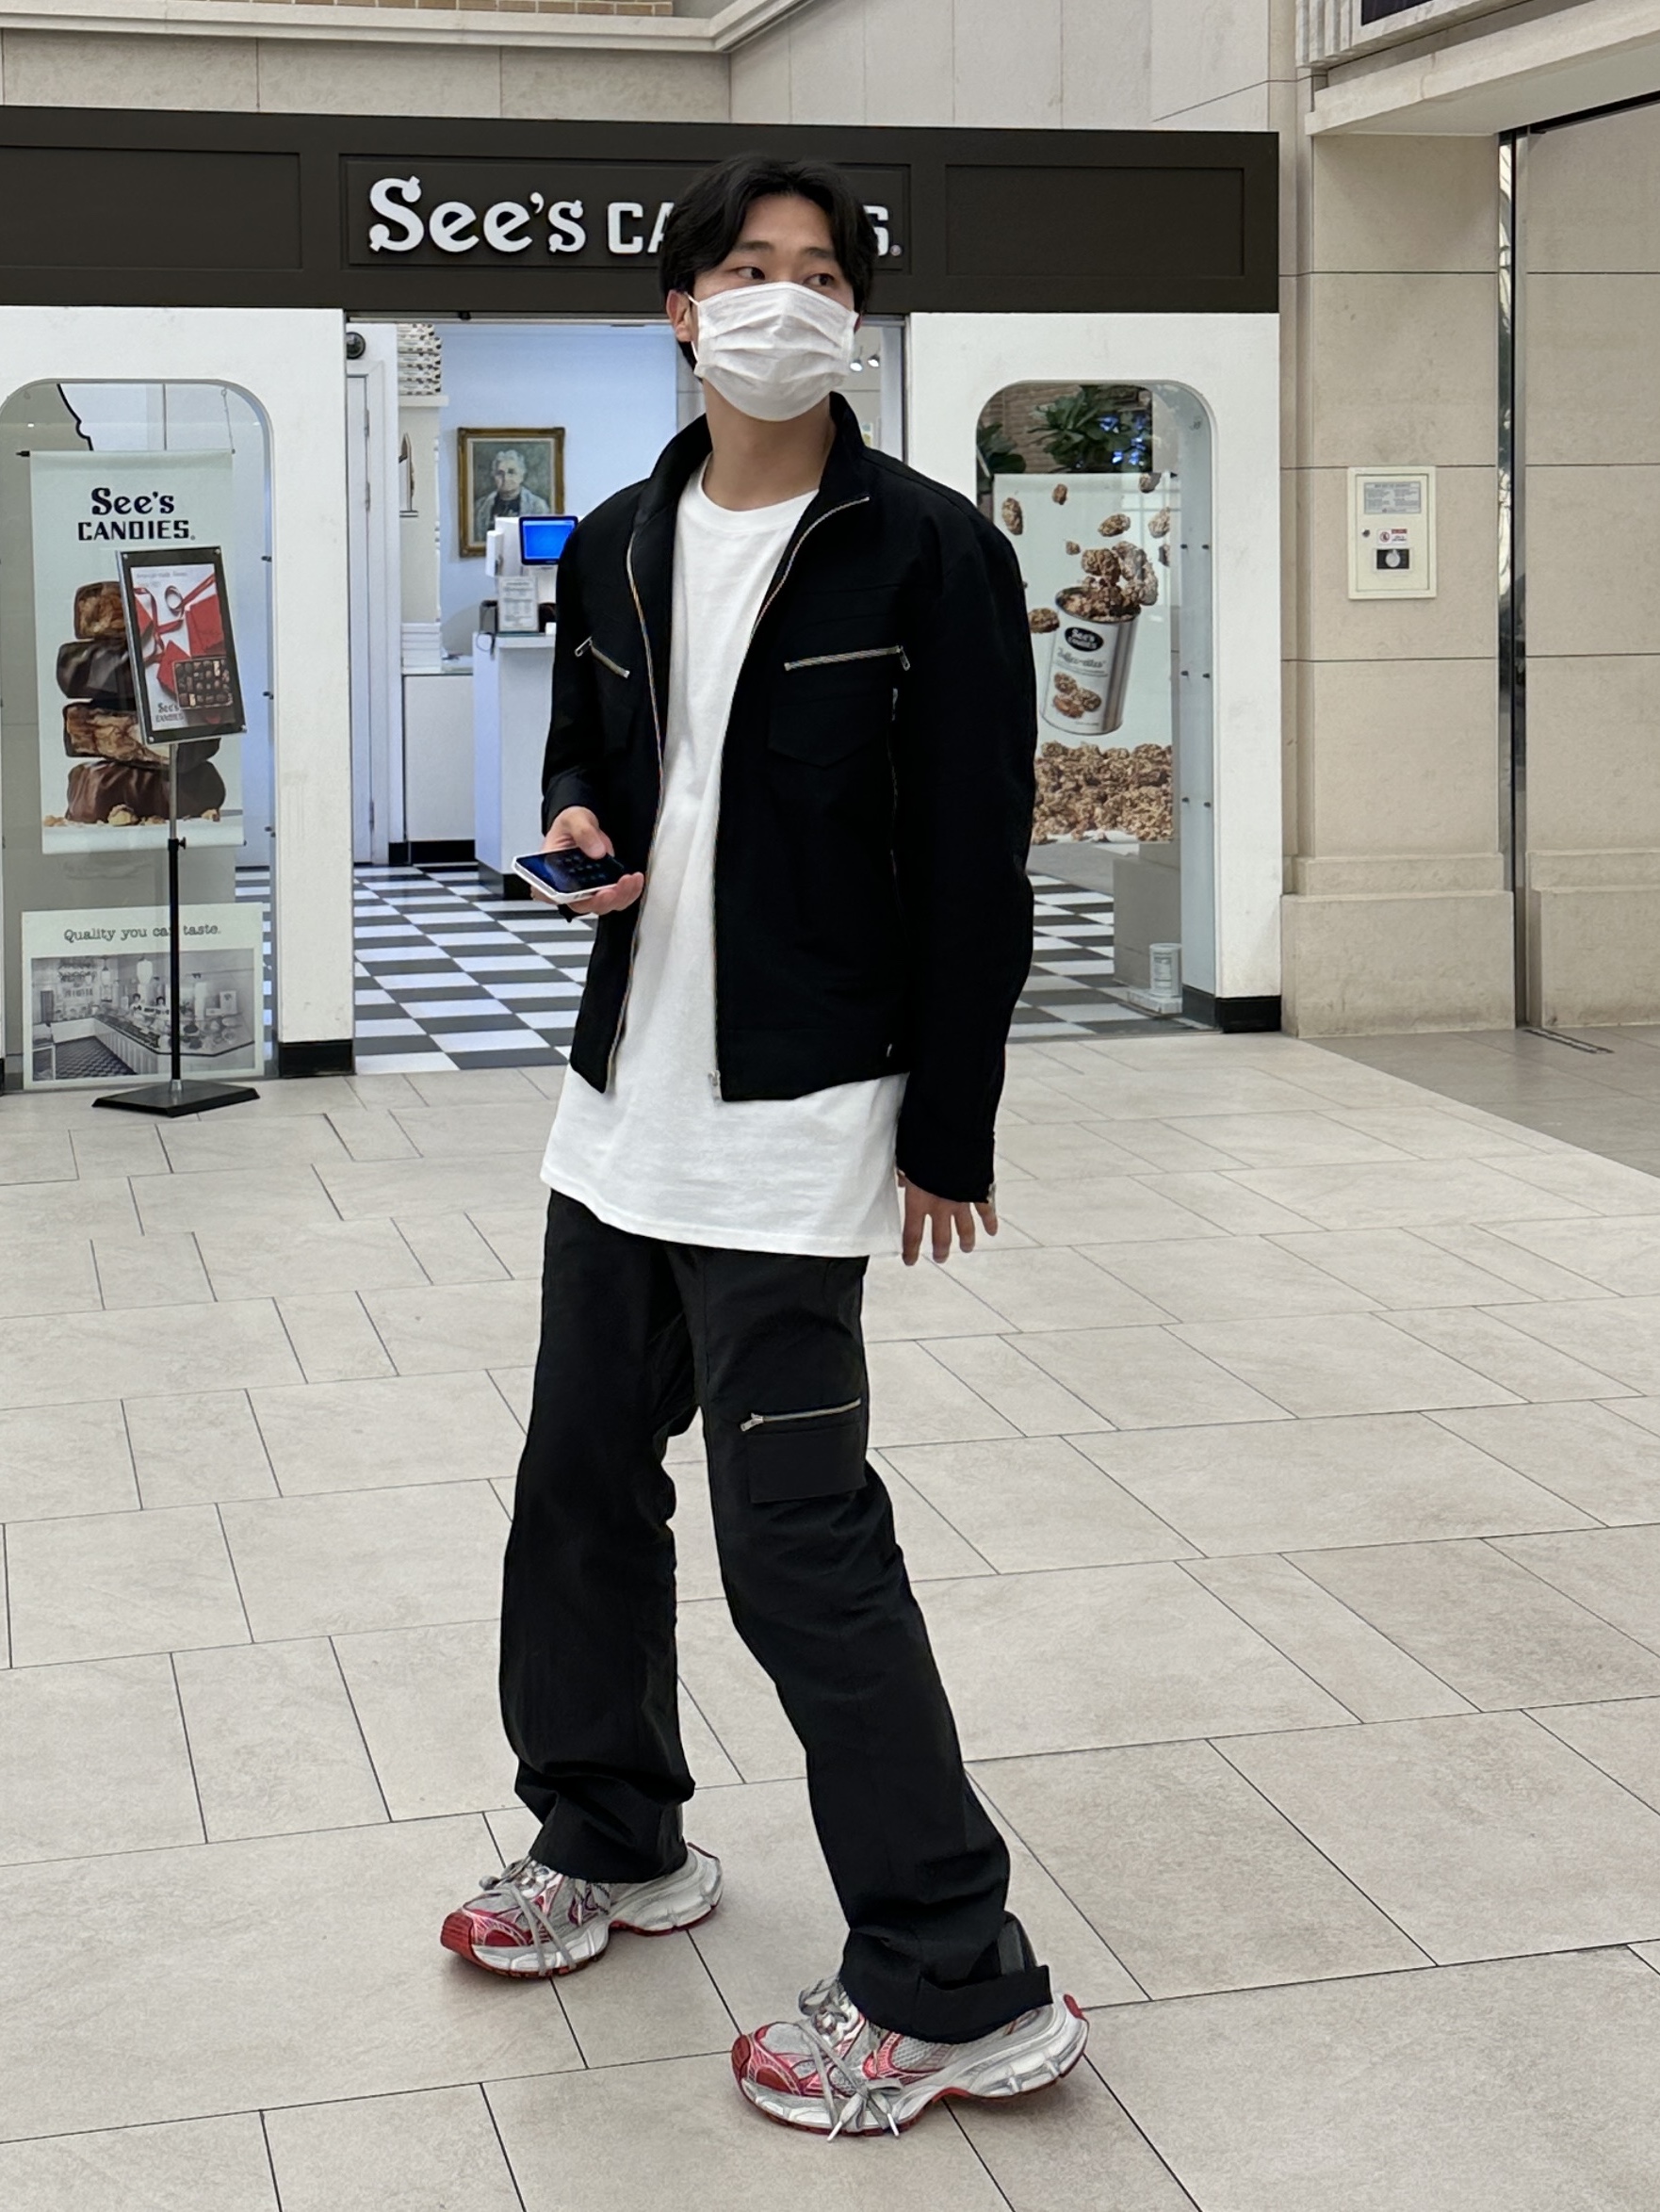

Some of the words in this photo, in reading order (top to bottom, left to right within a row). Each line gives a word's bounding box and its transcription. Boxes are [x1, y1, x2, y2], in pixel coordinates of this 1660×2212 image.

[369, 175, 586, 252] See's
[91, 487, 174, 515] See's
[63, 928, 116, 942] Quality
[121, 927, 147, 941] you
[153, 927, 171, 937] ca
